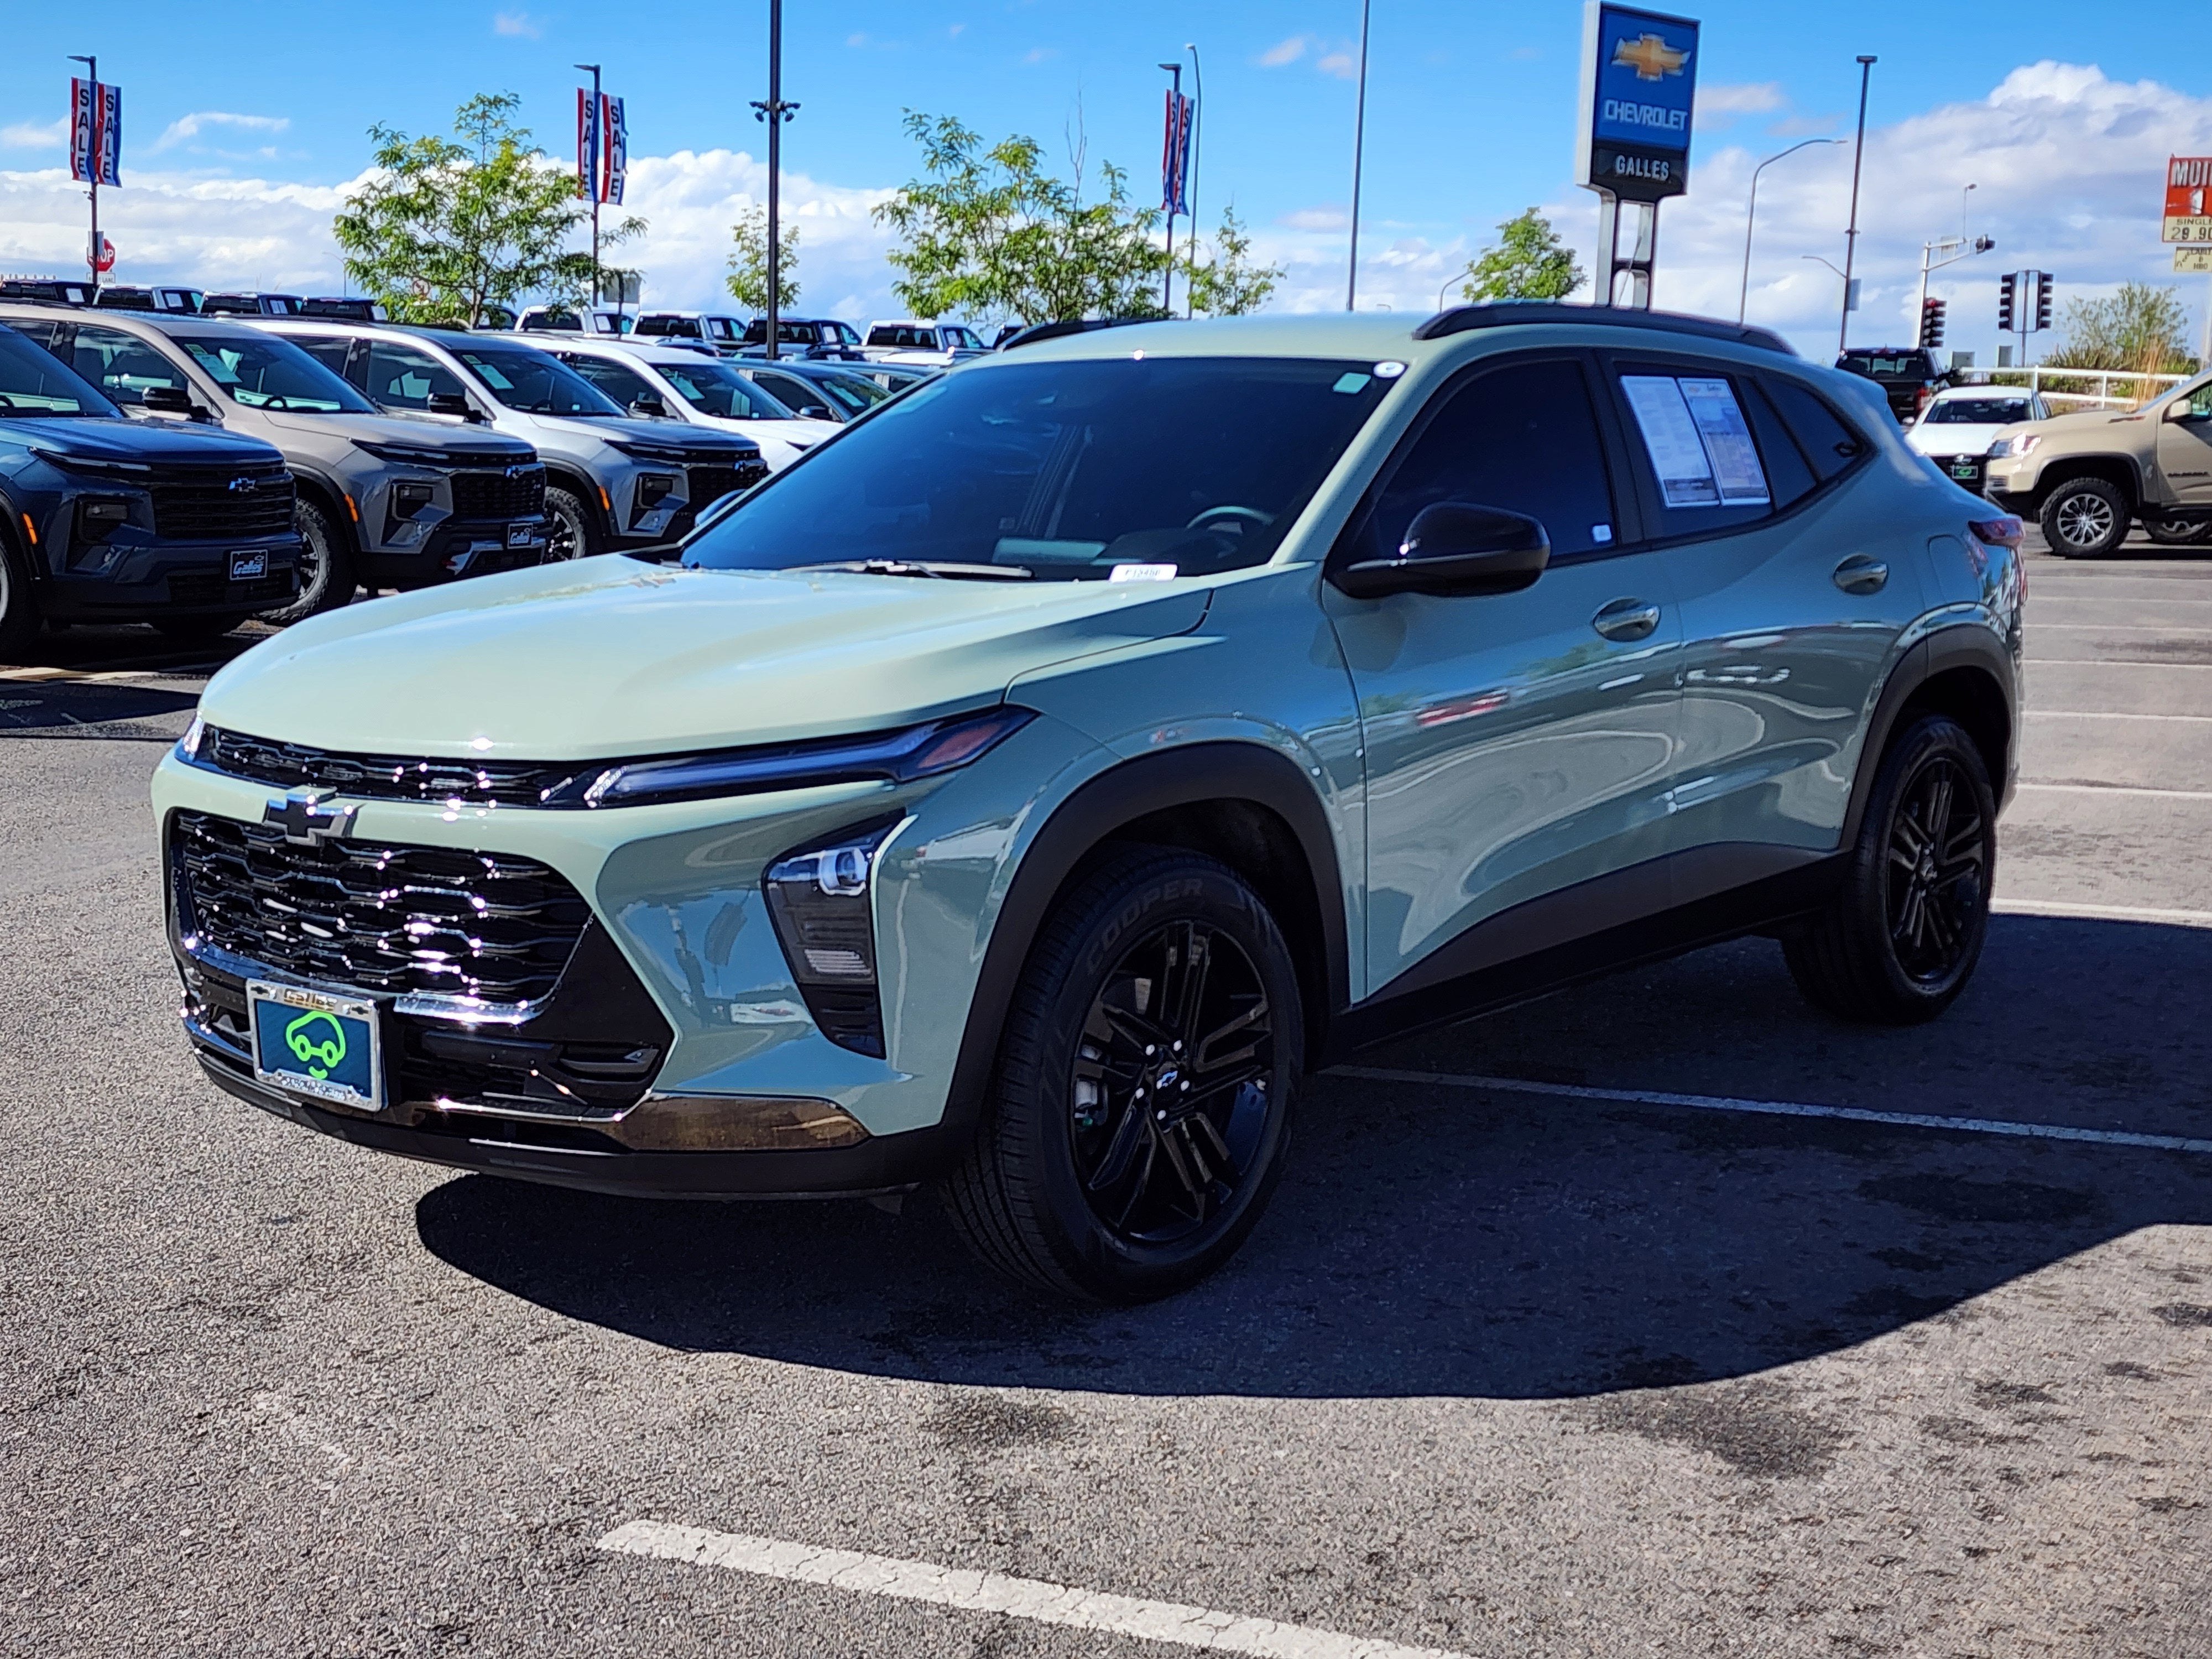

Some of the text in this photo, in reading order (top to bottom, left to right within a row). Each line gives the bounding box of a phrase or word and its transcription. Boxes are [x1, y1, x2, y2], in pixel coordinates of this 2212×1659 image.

[78, 88, 90, 175] SALE
[102, 94, 114, 179] SALE
[582, 100, 593, 193] SALE
[610, 105, 622, 197] SALE
[1605, 98, 1688, 131] CHEVROLET
[1615, 154, 1670, 181] GALLES
[1087, 878, 1203, 974] COOPER
